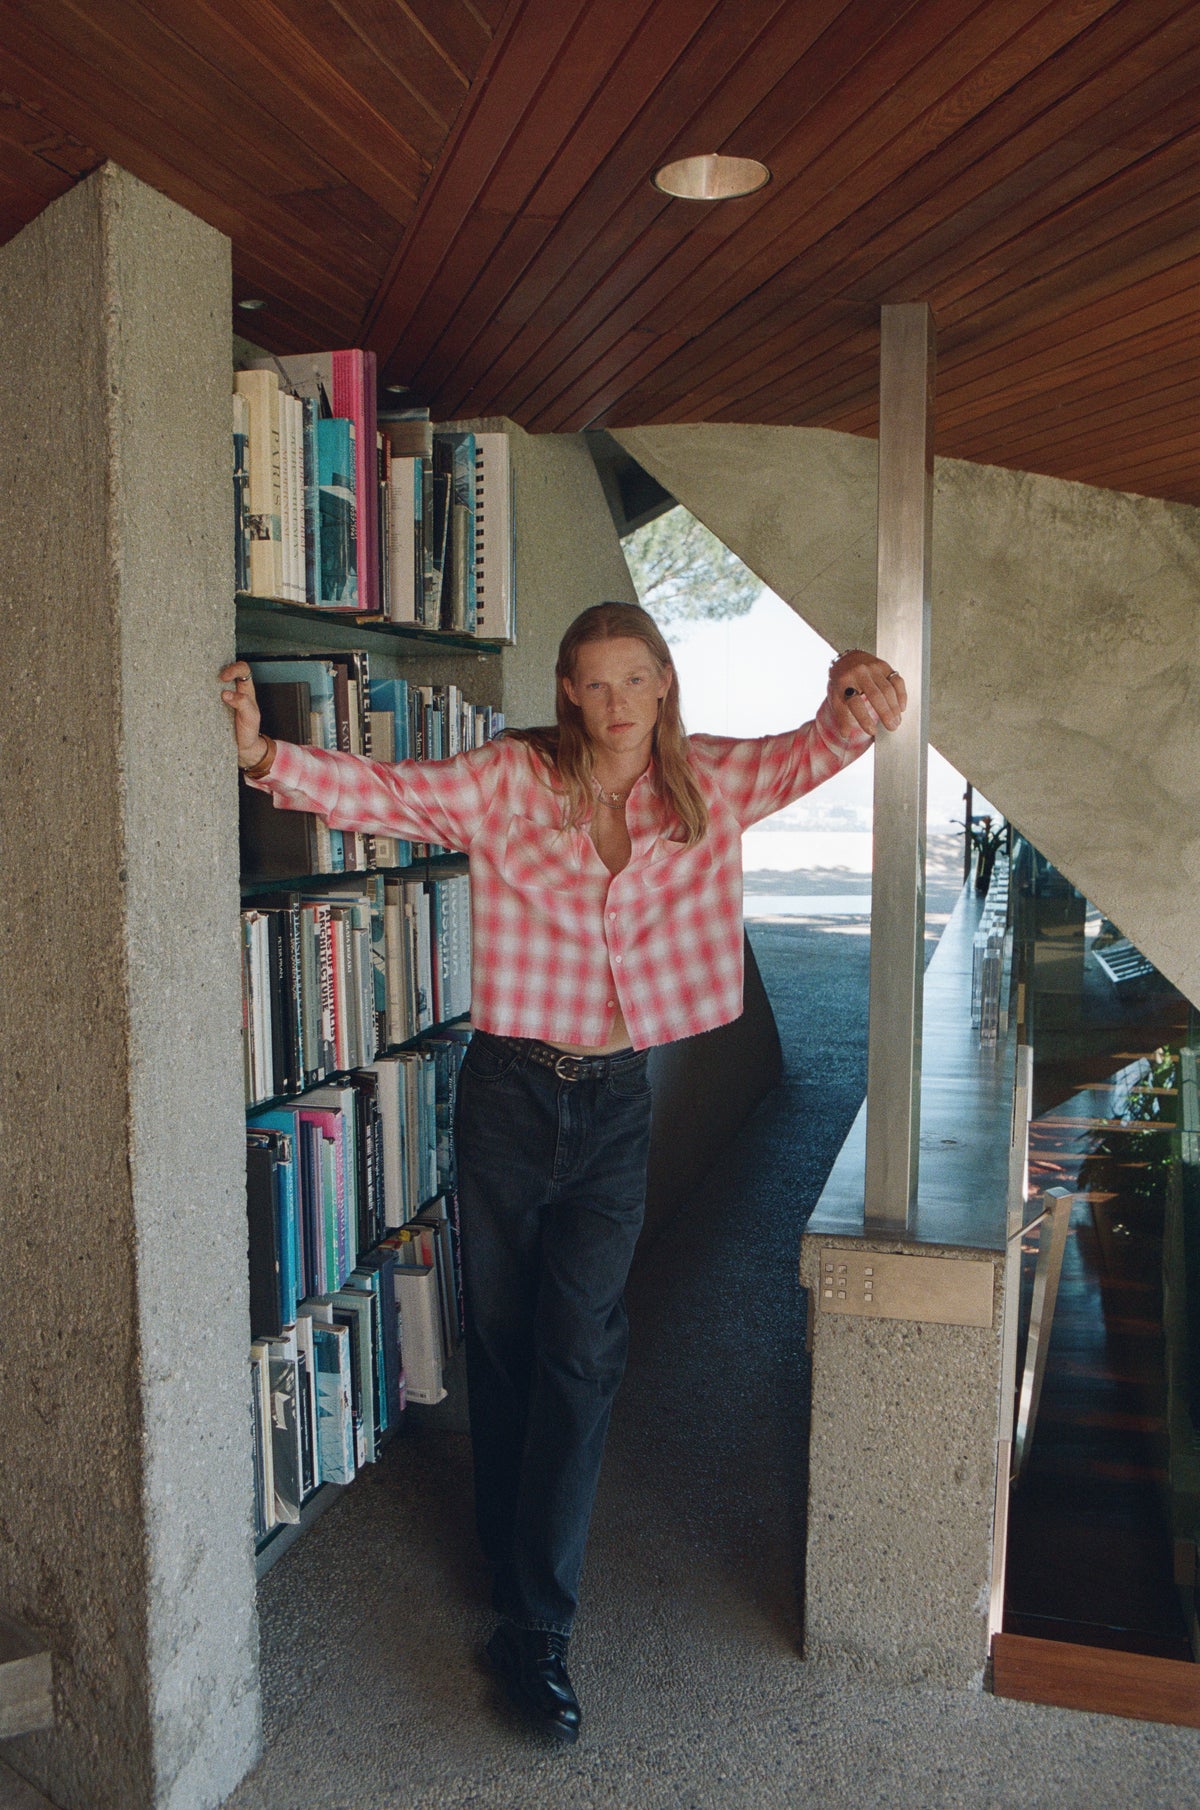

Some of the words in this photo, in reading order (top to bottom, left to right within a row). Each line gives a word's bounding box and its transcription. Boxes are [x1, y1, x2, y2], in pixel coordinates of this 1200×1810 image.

[271, 429, 281, 506] PARIS
[282, 448, 290, 537] MODERNISM
[342, 720, 350, 754] KAT
[319, 910, 330, 1013] ARCHITECTURE
[325, 909, 333, 949] ATLAS
[327, 955, 334, 970] OF
[328, 971, 337, 1044] BRUTALIST
